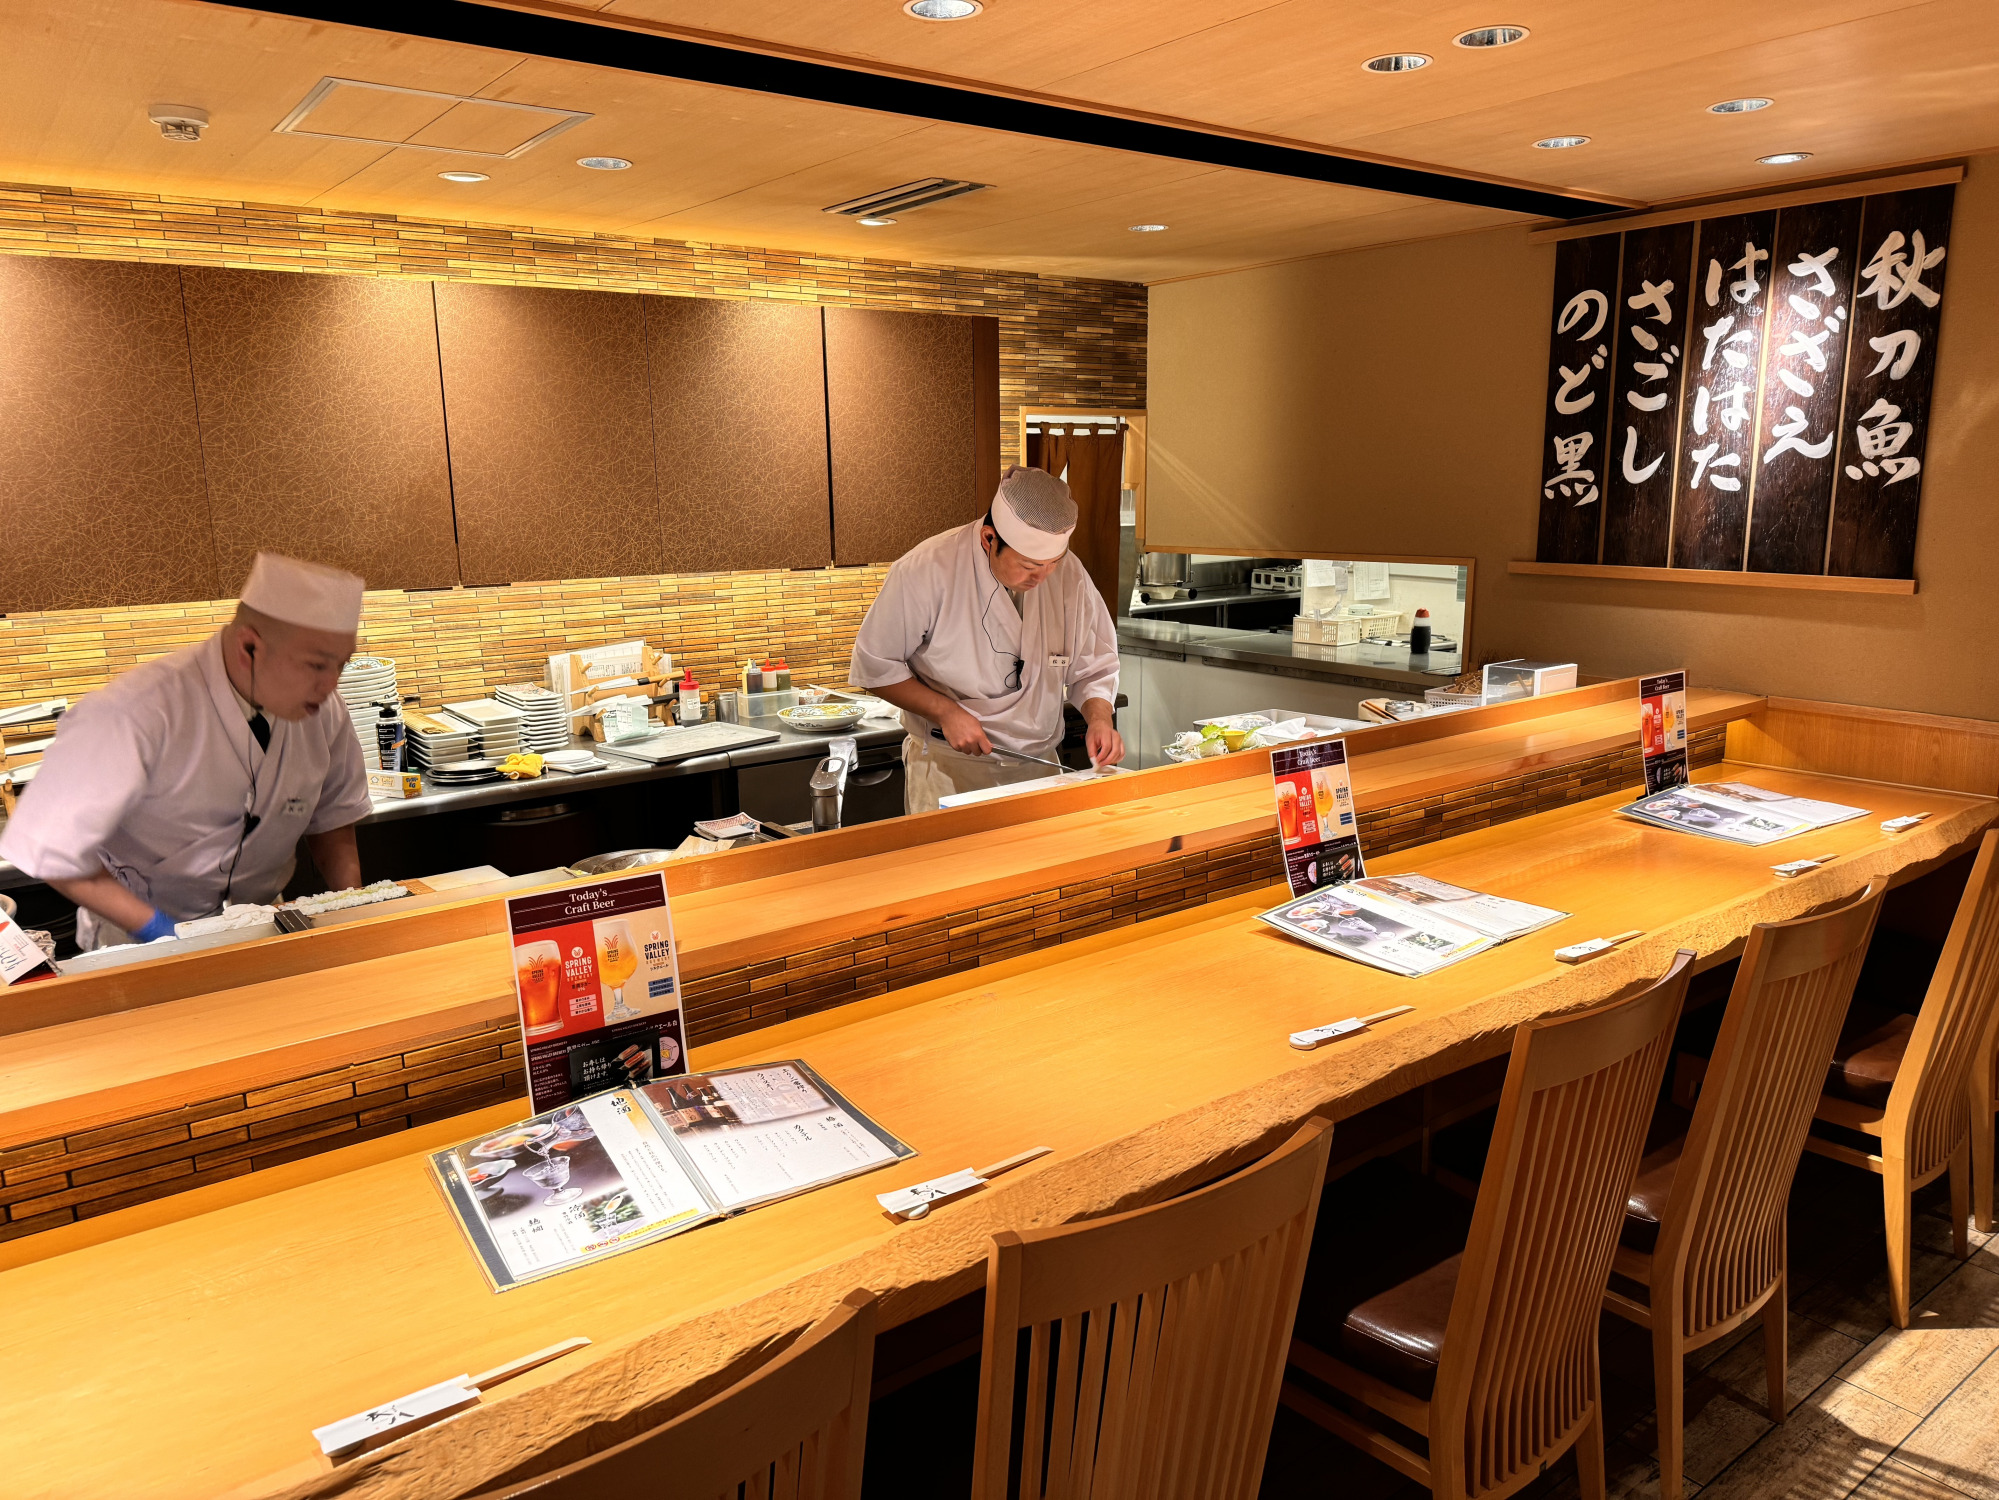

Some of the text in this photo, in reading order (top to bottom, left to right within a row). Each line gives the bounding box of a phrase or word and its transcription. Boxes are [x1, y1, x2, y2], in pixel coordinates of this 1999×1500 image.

[1764, 246, 1846, 465] さざえ
[1845, 229, 1946, 487] 秋刀魚
[1691, 241, 1769, 492] はたはた
[1622, 279, 1681, 485] さごし
[1544, 289, 1609, 508] のど黒
[568, 888, 608, 904] Today's
[564, 898, 616, 915] Craft Beer
[644, 940, 669, 952] SPRING
[645, 947, 670, 960] VALLEY
[565, 956, 592, 970] SPRING
[565, 964, 593, 978] VALLEY
[583, 1062, 612, 1076] お持ち帰り
